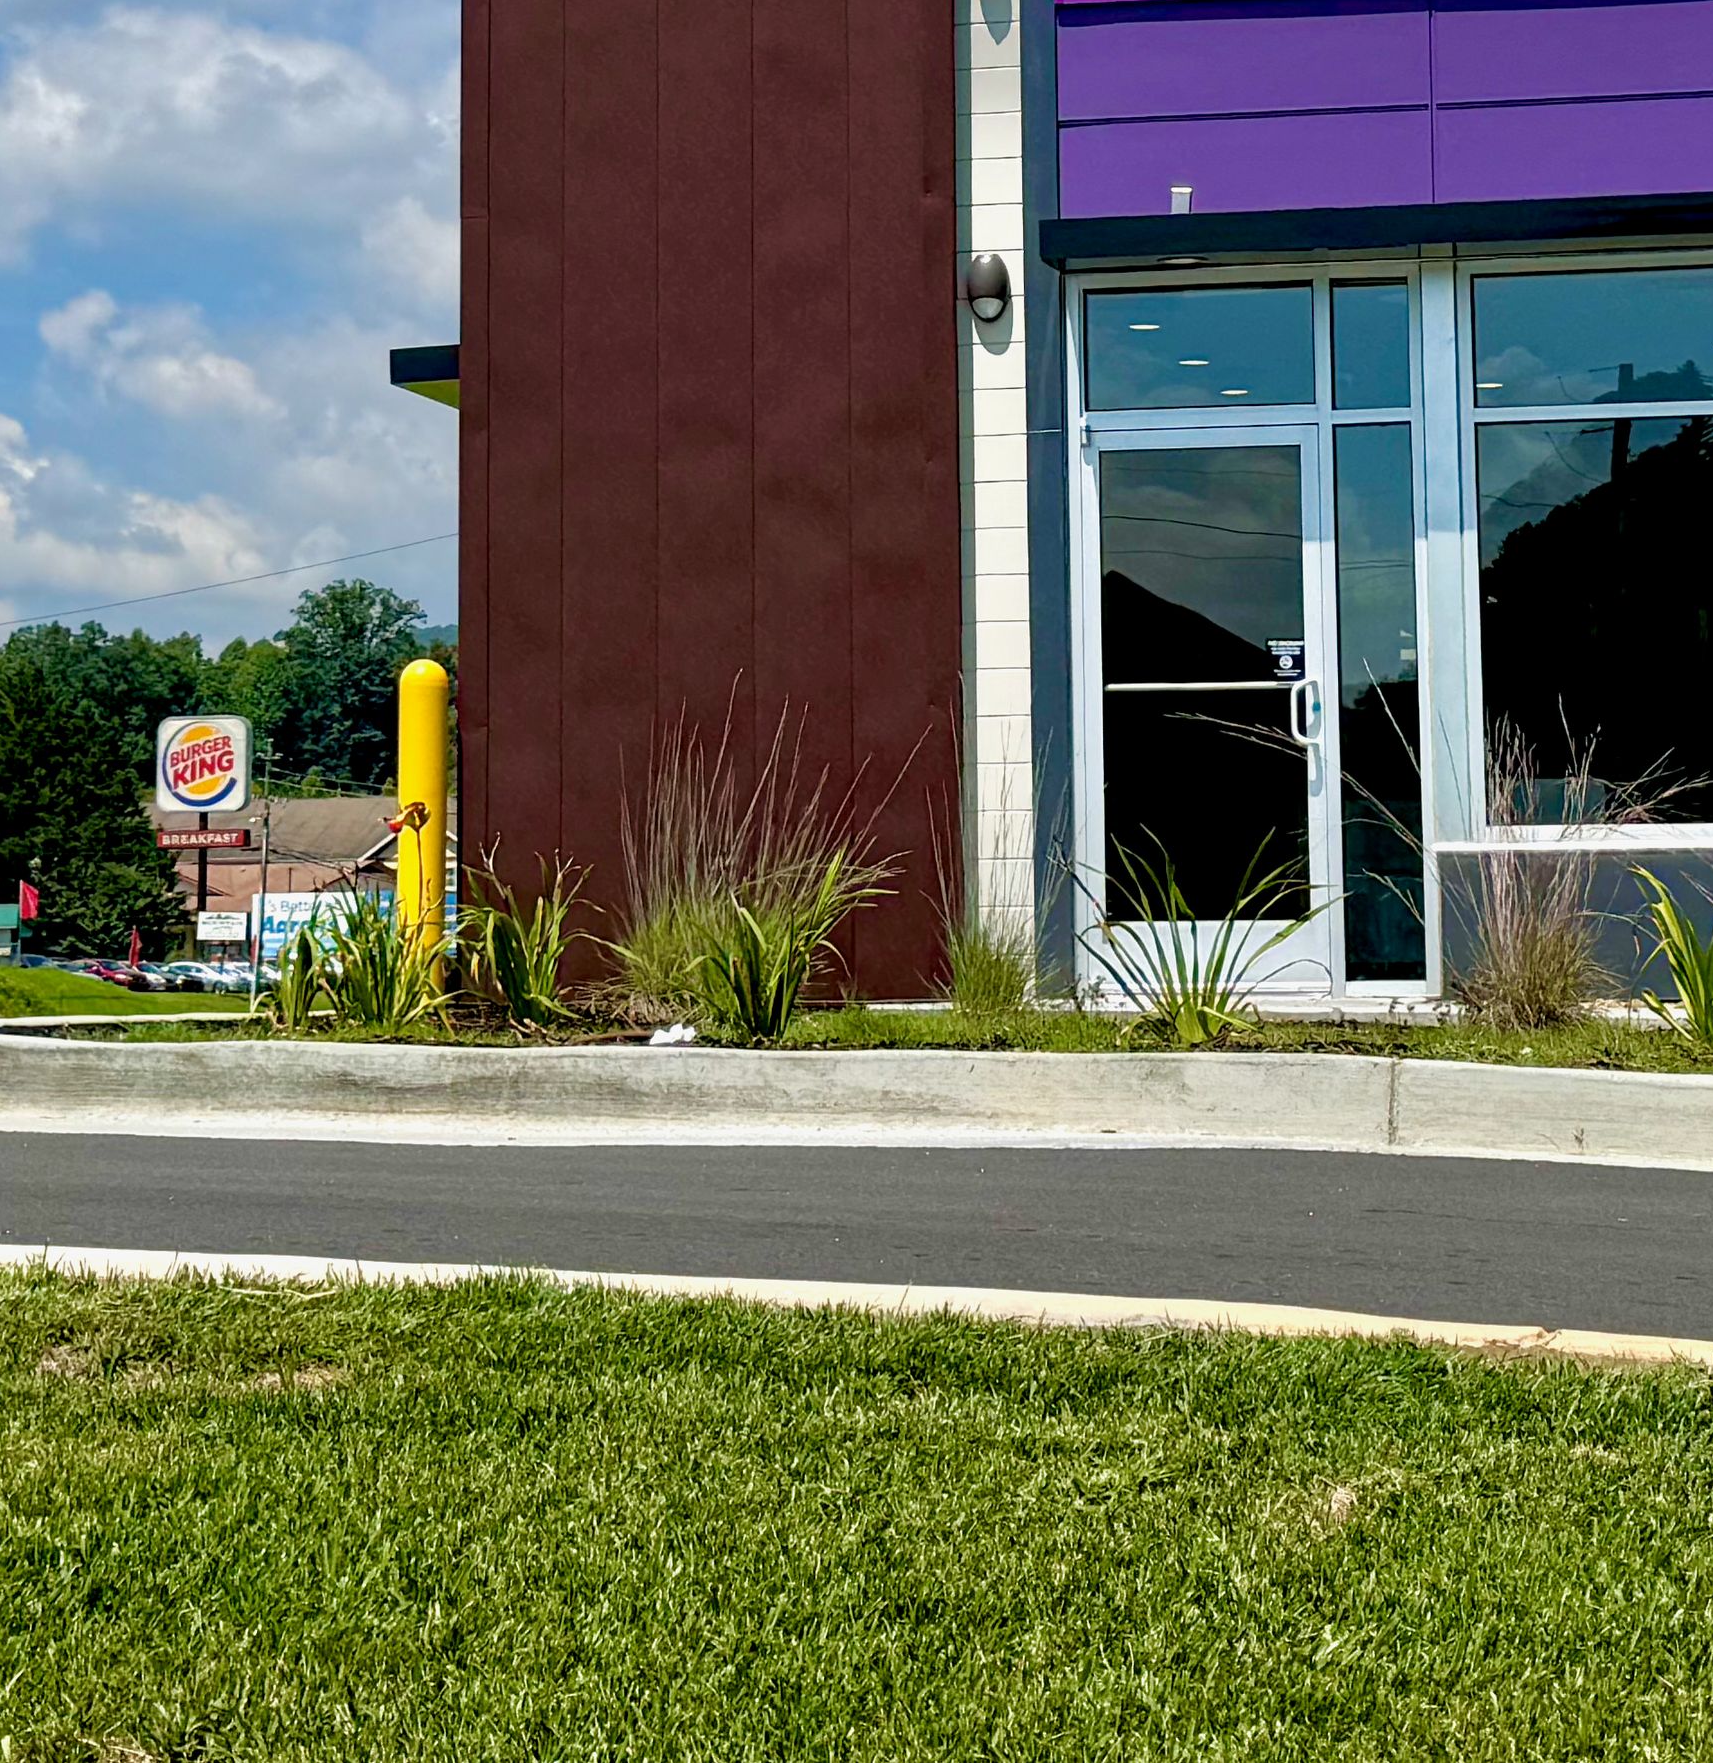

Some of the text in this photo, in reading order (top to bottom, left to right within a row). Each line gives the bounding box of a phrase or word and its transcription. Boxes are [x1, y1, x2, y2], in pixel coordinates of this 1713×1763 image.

[170, 735, 232, 768] BURGER
[172, 750, 235, 790] KING
[161, 833, 239, 846] BREAKFAST
